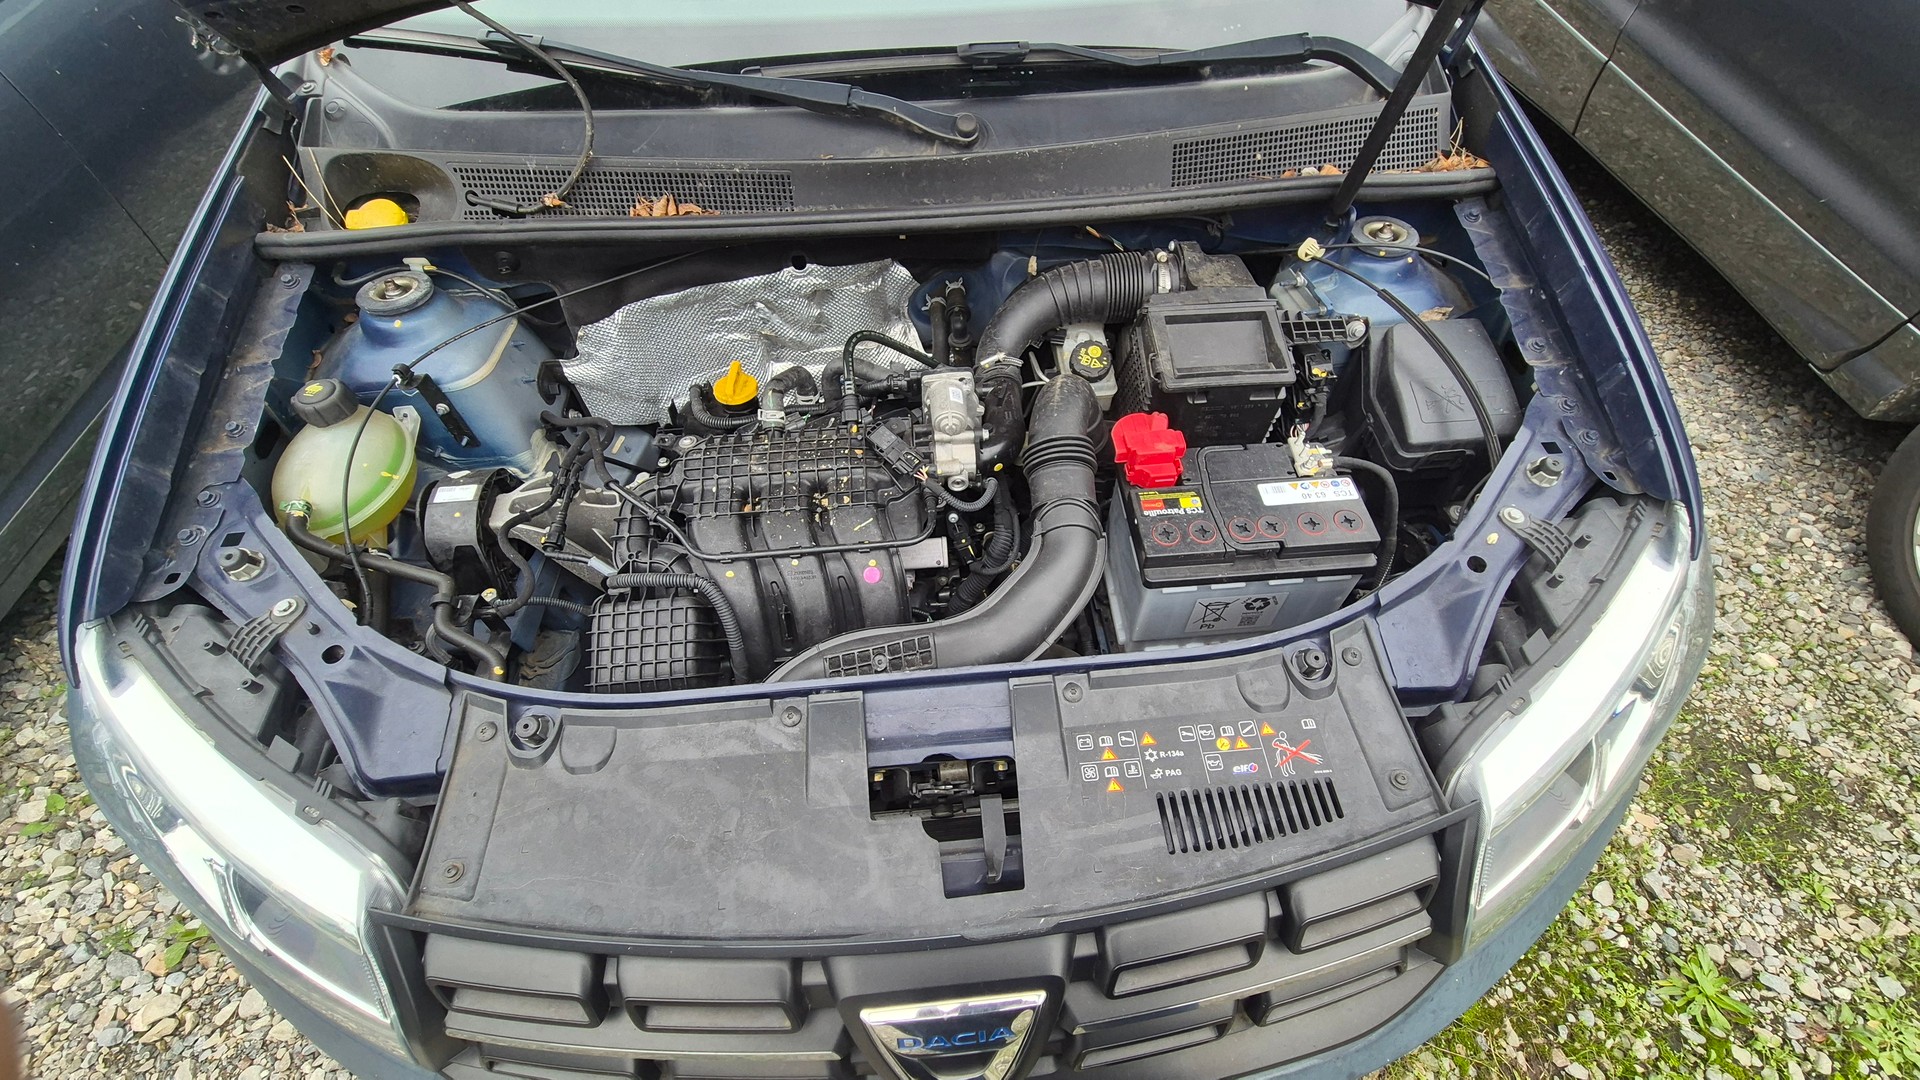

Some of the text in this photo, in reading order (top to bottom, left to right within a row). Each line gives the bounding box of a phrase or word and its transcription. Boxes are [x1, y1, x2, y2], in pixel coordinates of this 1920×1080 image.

[1301, 492, 1312, 500] 40
[1333, 489, 1354, 497] TCS
[1143, 508, 1185, 517] Patrouille
[1159, 750, 1185, 758] R-134a
[1164, 768, 1182, 777] PAG
[896, 1026, 1016, 1049] DACIA
